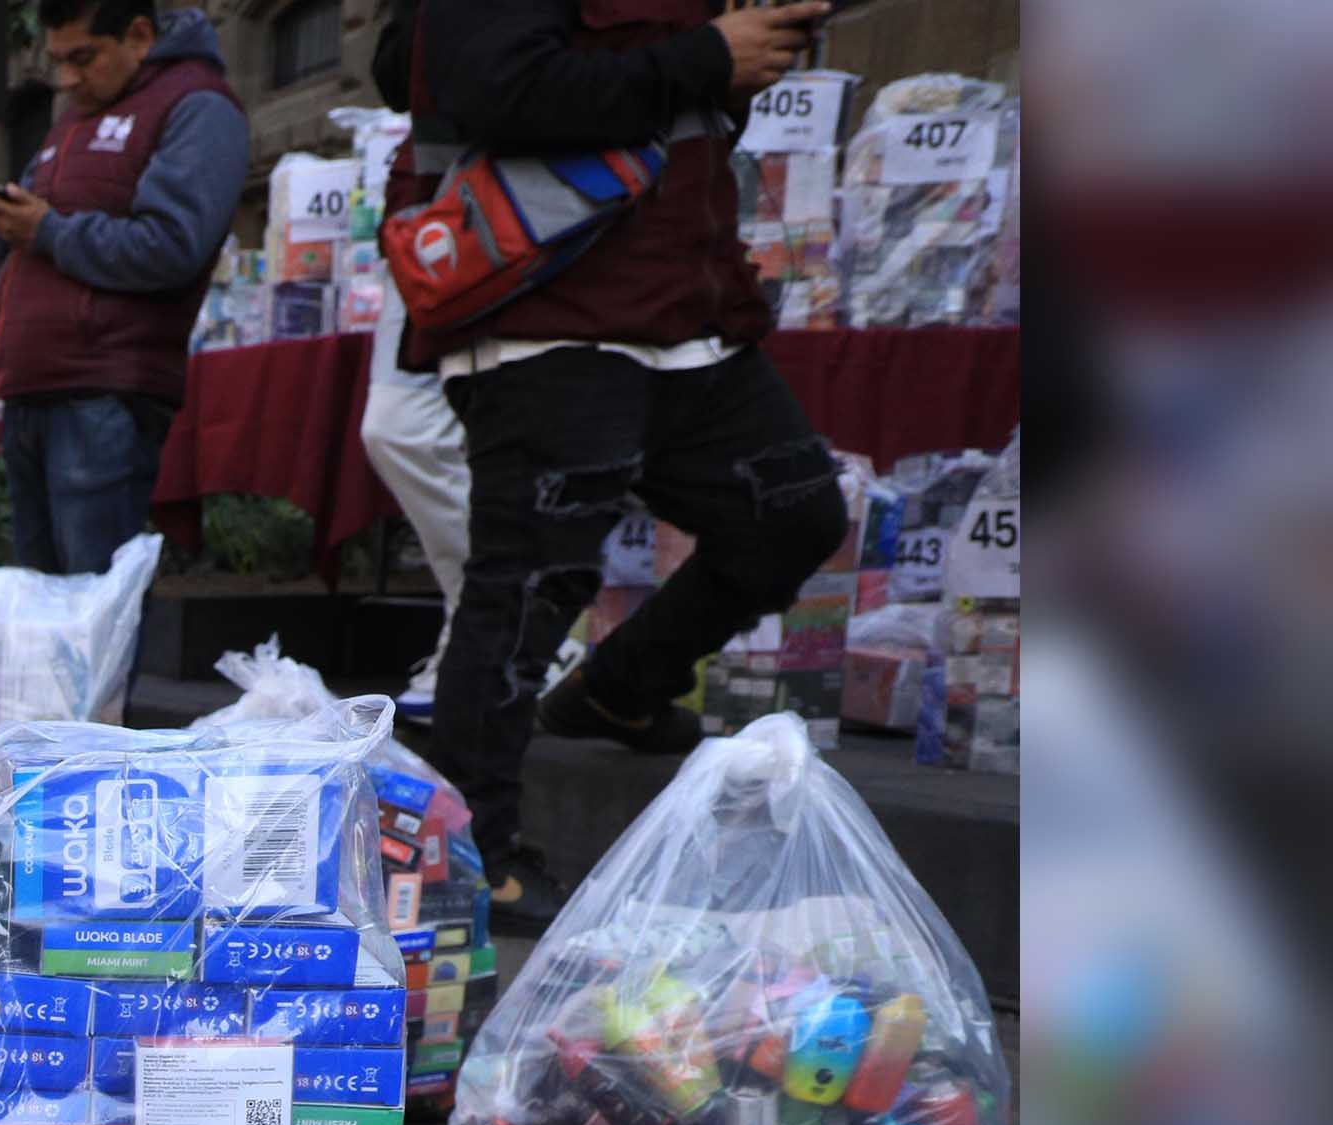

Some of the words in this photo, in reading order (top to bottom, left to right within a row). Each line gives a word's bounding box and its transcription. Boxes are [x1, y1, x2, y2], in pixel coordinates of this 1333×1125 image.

[755, 90, 813, 118] 405
[904, 121, 967, 150] 407
[308, 191, 347, 216] 40
[969, 511, 1017, 549] 45
[897, 538, 942, 567] 443
[123, 932, 163, 944] BLADE
[87, 956, 121, 967] MIAMI
